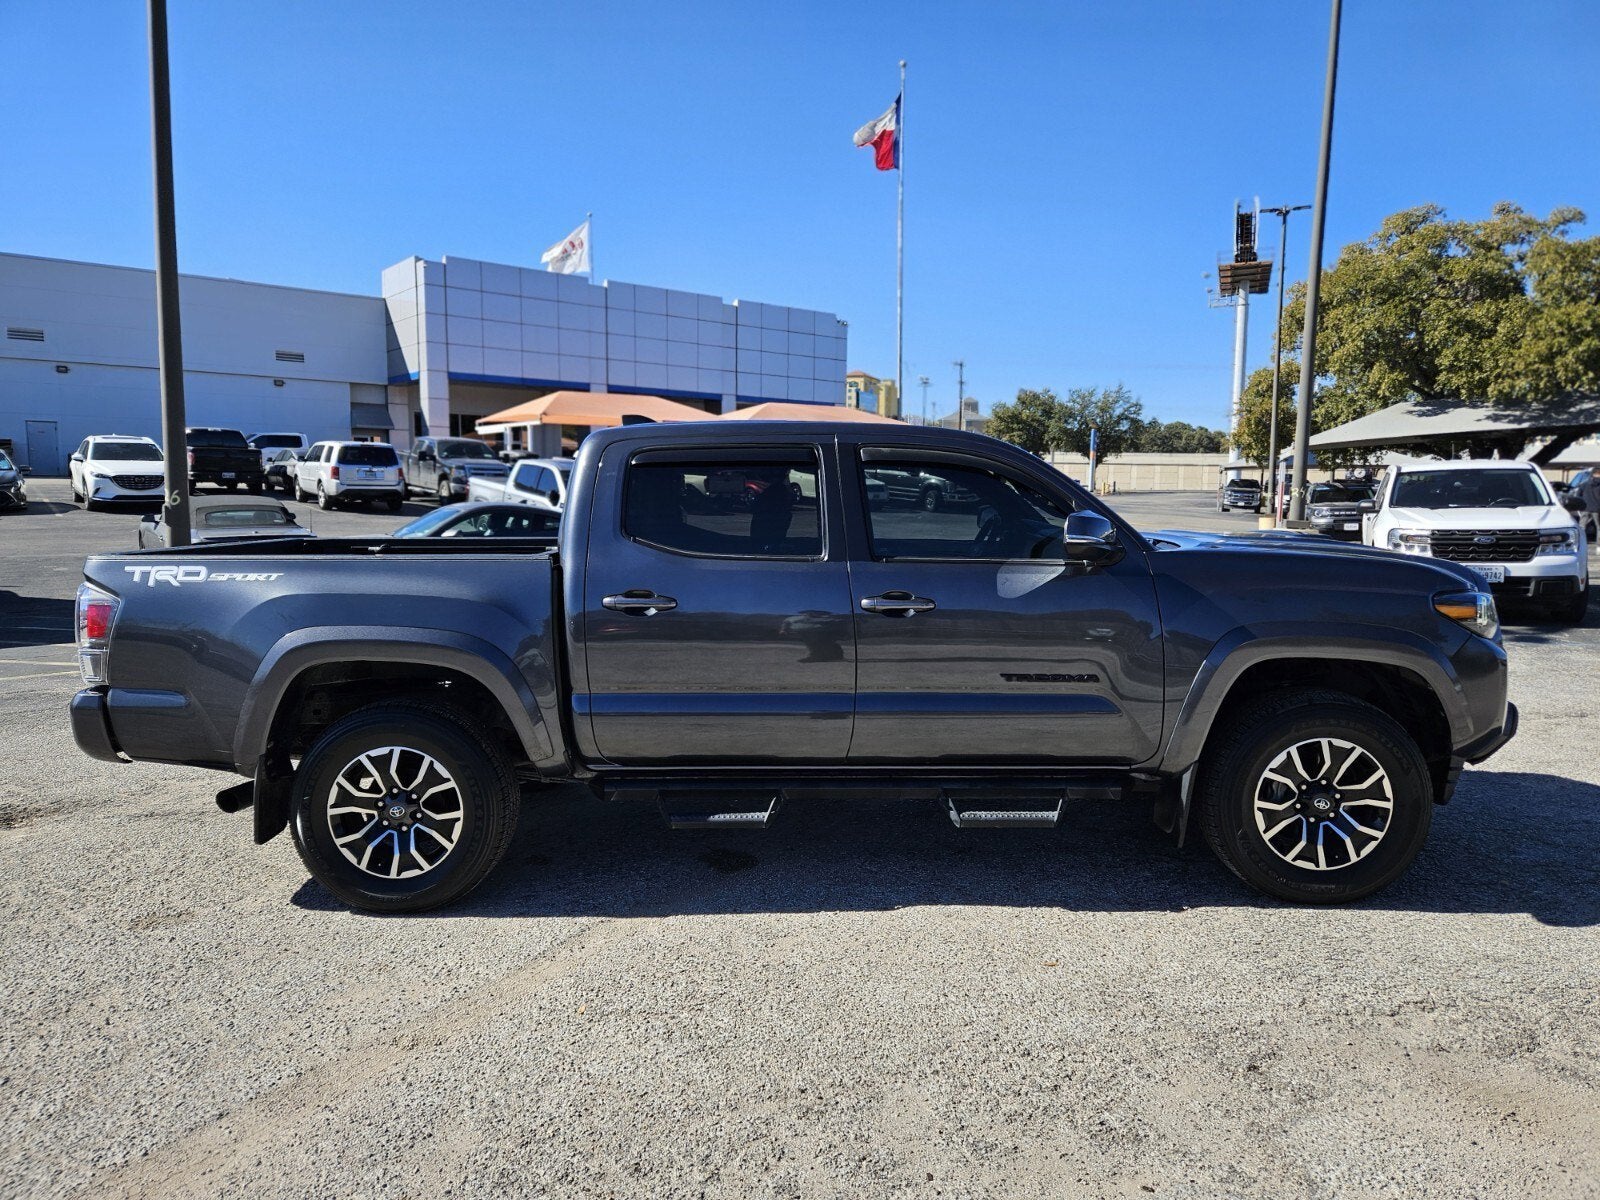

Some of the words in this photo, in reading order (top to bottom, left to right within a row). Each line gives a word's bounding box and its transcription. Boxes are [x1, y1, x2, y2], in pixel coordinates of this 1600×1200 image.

[124, 565, 208, 588] TRD
[207, 572, 285, 582] SPORT
[1000, 673, 1100, 683] TACOMA
